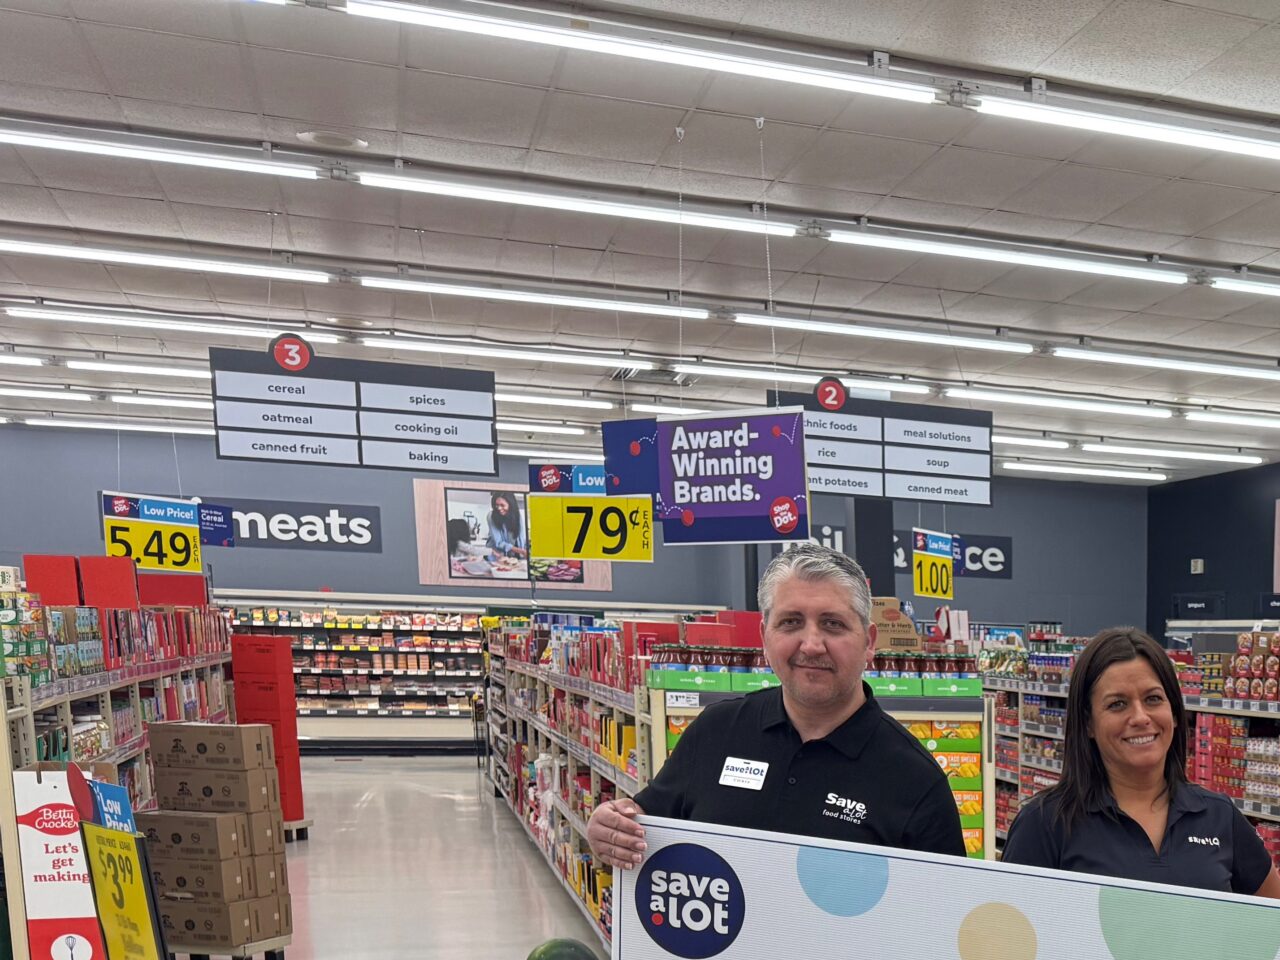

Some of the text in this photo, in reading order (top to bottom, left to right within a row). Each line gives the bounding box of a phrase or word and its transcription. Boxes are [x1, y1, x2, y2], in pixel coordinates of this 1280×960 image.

[285, 344, 301, 365] 3
[268, 383, 306, 396] cereal
[824, 387, 838, 405] 2
[409, 395, 446, 407] spices
[262, 412, 313, 425] oatmeal
[804, 419, 858, 432] hnic foods
[395, 422, 458, 437] cooking oil
[671, 422, 759, 450] Award-
[904, 428, 971, 443] meal solutions
[252, 441, 328, 456] canned fruit
[818, 448, 836, 458] rice
[409, 451, 449, 465] baking
[671, 449, 773, 480] Winning
[926, 457, 949, 468] soup
[579, 473, 605, 485] Low
[825, 477, 868, 489] potatoes
[674, 478, 761, 504] Brands.
[908, 484, 968, 496] canned meat
[144, 505, 165, 515] Low
[167, 507, 194, 519] Price!
[773, 503, 790, 514] Shop
[201, 513, 224, 523] Cereal
[774, 513, 797, 528] Dot.
[642, 511, 650, 549] EACH
[110, 526, 191, 566] 5.49
[916, 560, 949, 594] 1.00
[102, 797, 121, 813] Low
[825, 792, 866, 811] Save
[35, 815, 79, 829] Crocker
[42, 808, 74, 822] Betty
[822, 809, 861, 825] food stores
[44, 843, 79, 855] Let's
[52, 857, 74, 870] get
[33, 871, 90, 884] making
[651, 870, 729, 901] save
[650, 894, 665, 912] a
